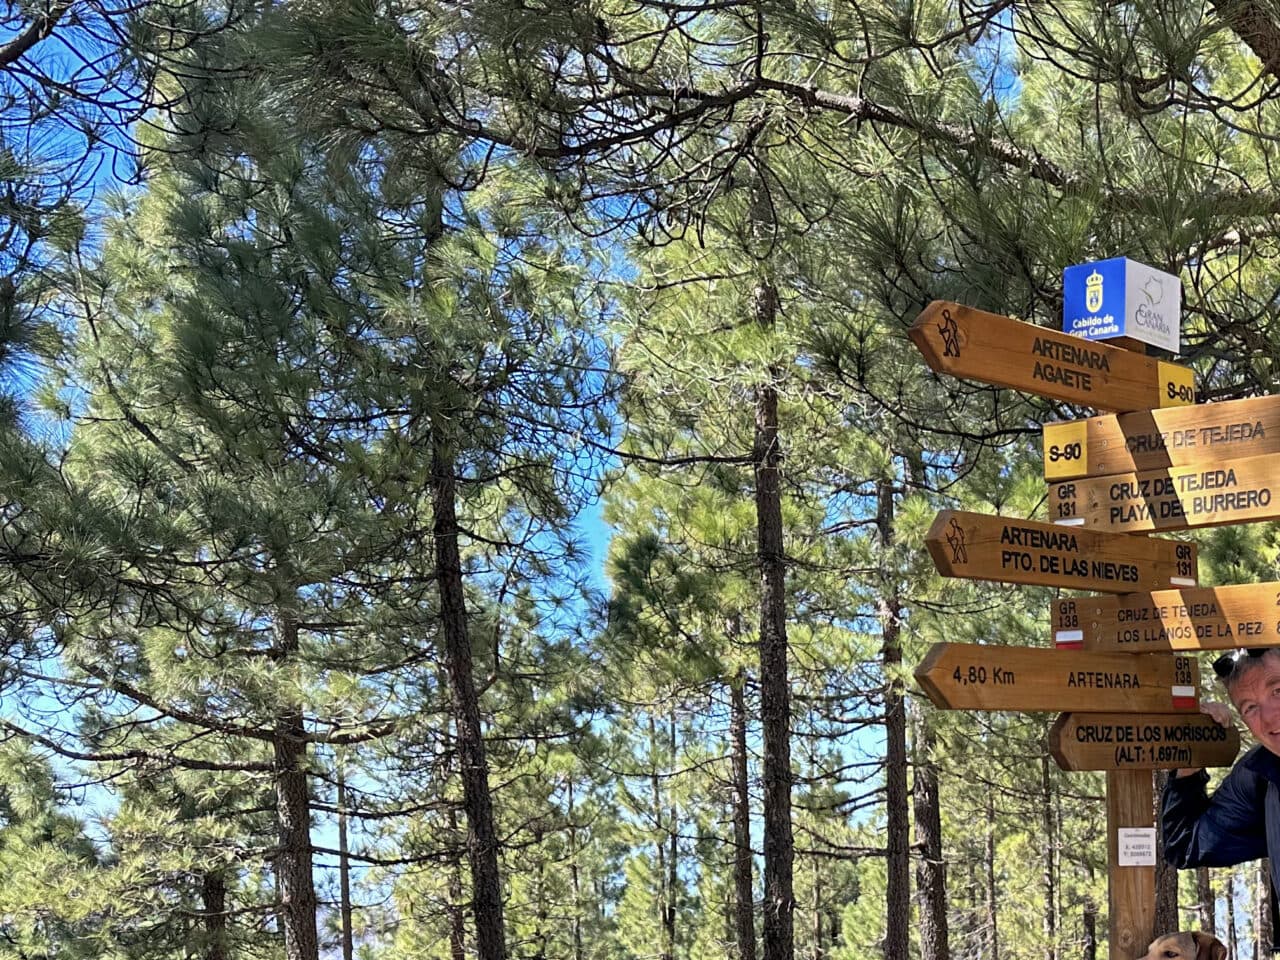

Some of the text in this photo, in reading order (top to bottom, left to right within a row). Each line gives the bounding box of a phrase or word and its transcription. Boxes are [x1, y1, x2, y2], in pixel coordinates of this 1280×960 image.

[1072, 314, 1114, 329] Cabildo de
[1088, 324, 1119, 336] Canaria
[1032, 337, 1110, 373] ARTENARA
[1033, 361, 1092, 391] AGAETE
[1167, 382, 1193, 403] S-90
[1126, 421, 1265, 452] CRUZ DE TEJEDA
[1049, 442, 1081, 462] S-90
[1057, 484, 1077, 500] GR
[1110, 469, 1237, 501] CRUZ DE TEJEDA
[1057, 501, 1077, 517] 131
[1110, 488, 1271, 524] PLAYA DEL BURRERO
[1001, 526, 1079, 552] ARTENARA
[1175, 544, 1192, 560] GR
[1002, 551, 1138, 582] PTO. DE LAS NIEVES
[1176, 561, 1192, 576] 131
[1059, 602, 1077, 615] GR
[1117, 608, 1148, 622] CRUZ
[1153, 606, 1168, 619] DE
[1171, 603, 1218, 619] TEJEDA
[1059, 615, 1079, 628] 138
[1117, 628, 1140, 643] LOS
[1144, 626, 1192, 642] LLANOS
[1197, 624, 1213, 638] DE
[1217, 623, 1233, 637] LA
[1238, 621, 1263, 635] PEZ
[1175, 657, 1190, 671] GR
[953, 665, 1140, 689] 4,80 Km ARTENARA
[1175, 671, 1192, 684] 138
[1076, 724, 1227, 742] CRUZ DE LOS MORISCOS
[1115, 746, 1192, 765] (ALT: 1.697m)
